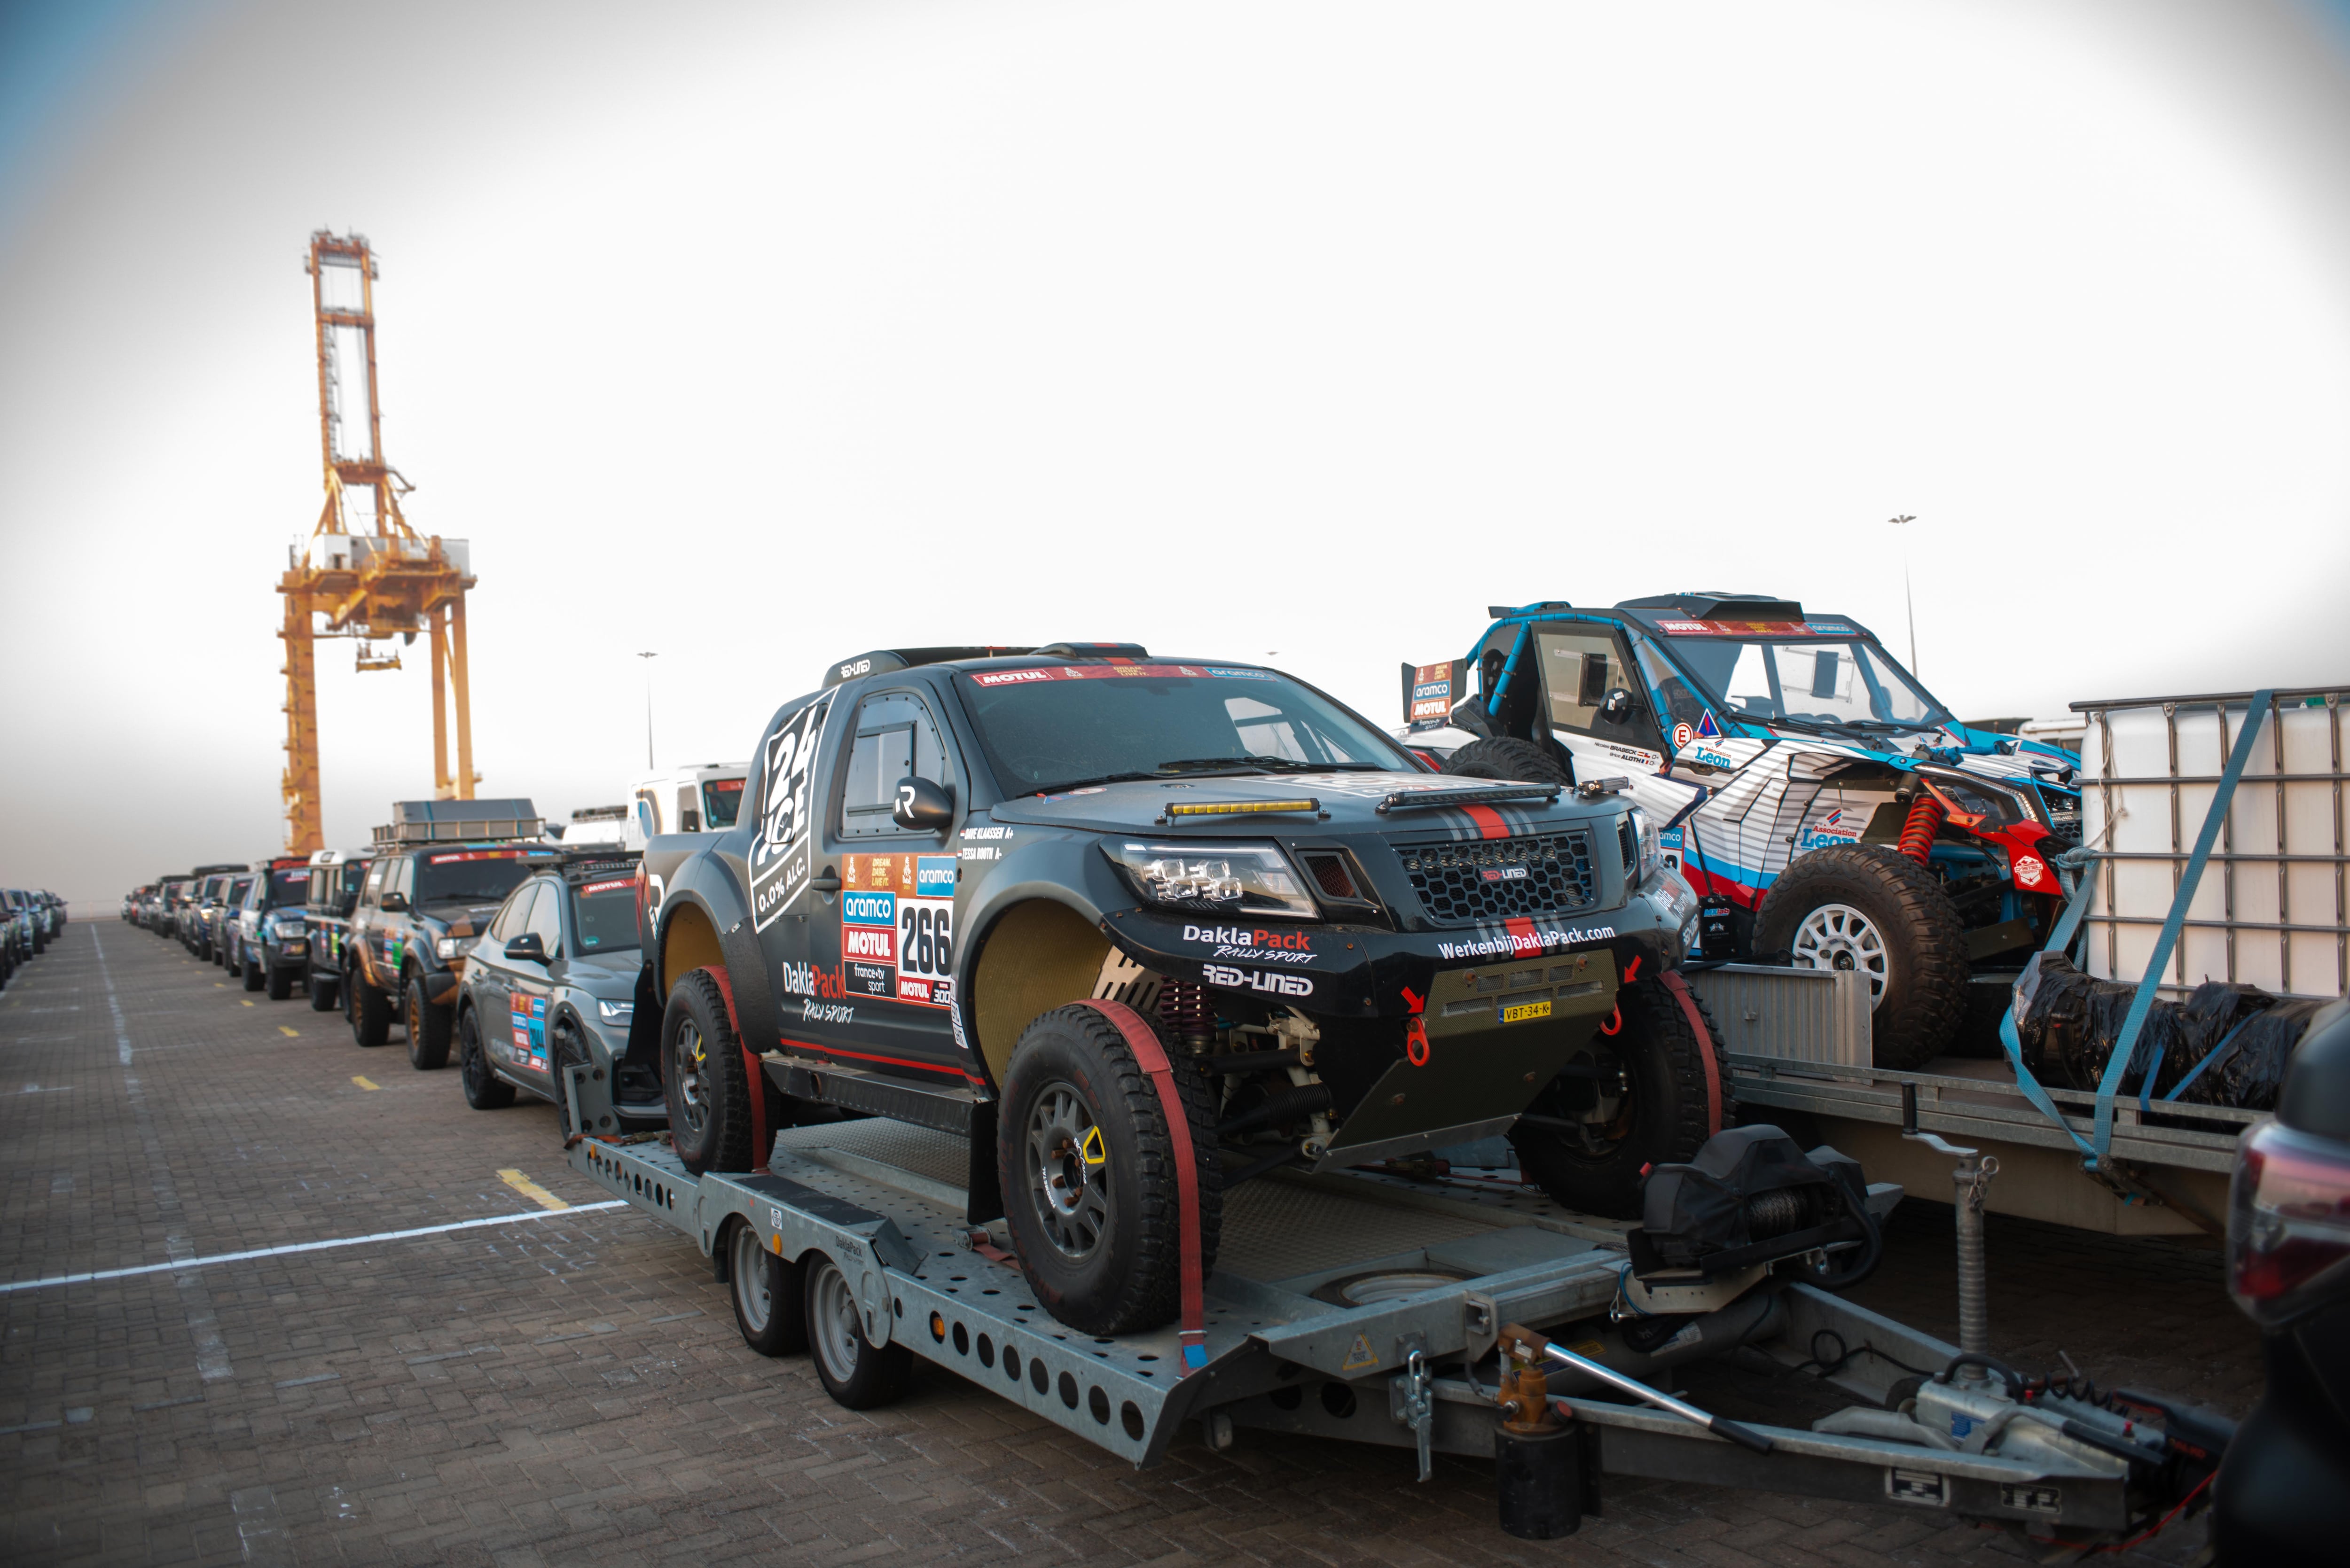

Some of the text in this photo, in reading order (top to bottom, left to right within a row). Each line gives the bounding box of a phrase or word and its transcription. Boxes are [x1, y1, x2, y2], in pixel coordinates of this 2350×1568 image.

[1664, 622, 1708, 631] MOTUL
[841, 659, 870, 679] RED-LINED
[983, 669, 1047, 683] MOTUL
[1212, 669, 1265, 678] aramco
[1416, 684, 1448, 697] aramco
[1414, 701, 1447, 716] MOTUL
[1678, 730, 1686, 742] E
[1610, 745, 1637, 755] BRABECK
[1695, 746, 1731, 769] Leon
[1660, 831, 1681, 842] amco
[1812, 826, 1857, 837] Association
[872, 858, 892, 867] DREAM.
[872, 867, 886, 877] DARE.
[919, 870, 954, 884] aramco
[1482, 867, 1527, 880] RED-LINED
[759, 857, 806, 913] 0.0% ALC.
[871, 878, 883, 886] LIVE
[846, 898, 891, 918] aramco
[847, 931, 891, 956] MOTUL
[902, 907, 951, 976] 266
[1183, 925, 1311, 950] DaklaPack
[1438, 925, 1615, 960] WerkenbijDaklaPack.com
[1213, 945, 1318, 964] RALLY SPORT
[783, 961, 847, 999] DaklaPack
[1202, 964, 1314, 996] RED-LINED
[868, 981, 885, 995] sport
[901, 981, 930, 999] MOTUL
[824, 1004, 854, 1024] SPORT
[1506, 1004, 1548, 1020] VBT-34-K
